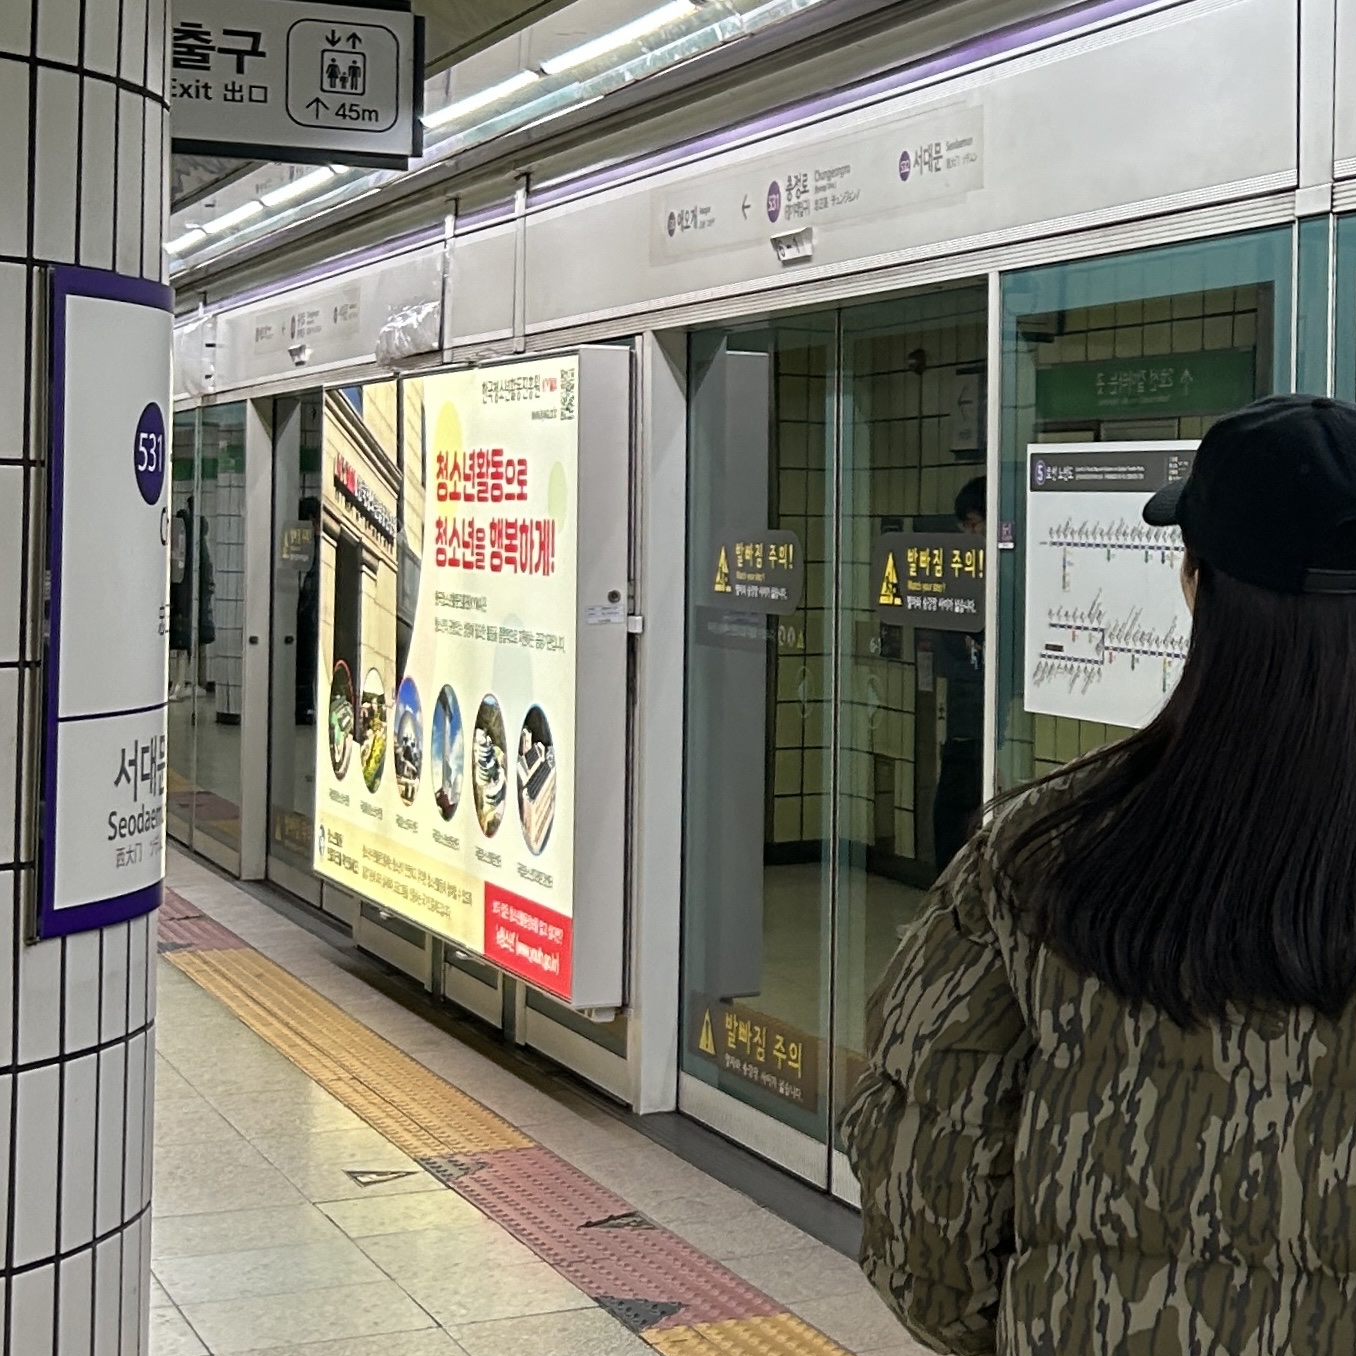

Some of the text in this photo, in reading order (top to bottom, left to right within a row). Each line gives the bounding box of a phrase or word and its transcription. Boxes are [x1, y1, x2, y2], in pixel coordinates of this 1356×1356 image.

[173, 21, 266, 74] 출구
[223, 81, 268, 103] 出口
[335, 103, 379, 123] 45m
[138, 432, 163, 473] 531
[436, 448, 528, 503] 청소년활동으로
[435, 516, 556, 577] 청소년을 행복하게!
[951, 549, 984, 579] 주의!
[725, 1012, 803, 1080] 발빠짐 주의
